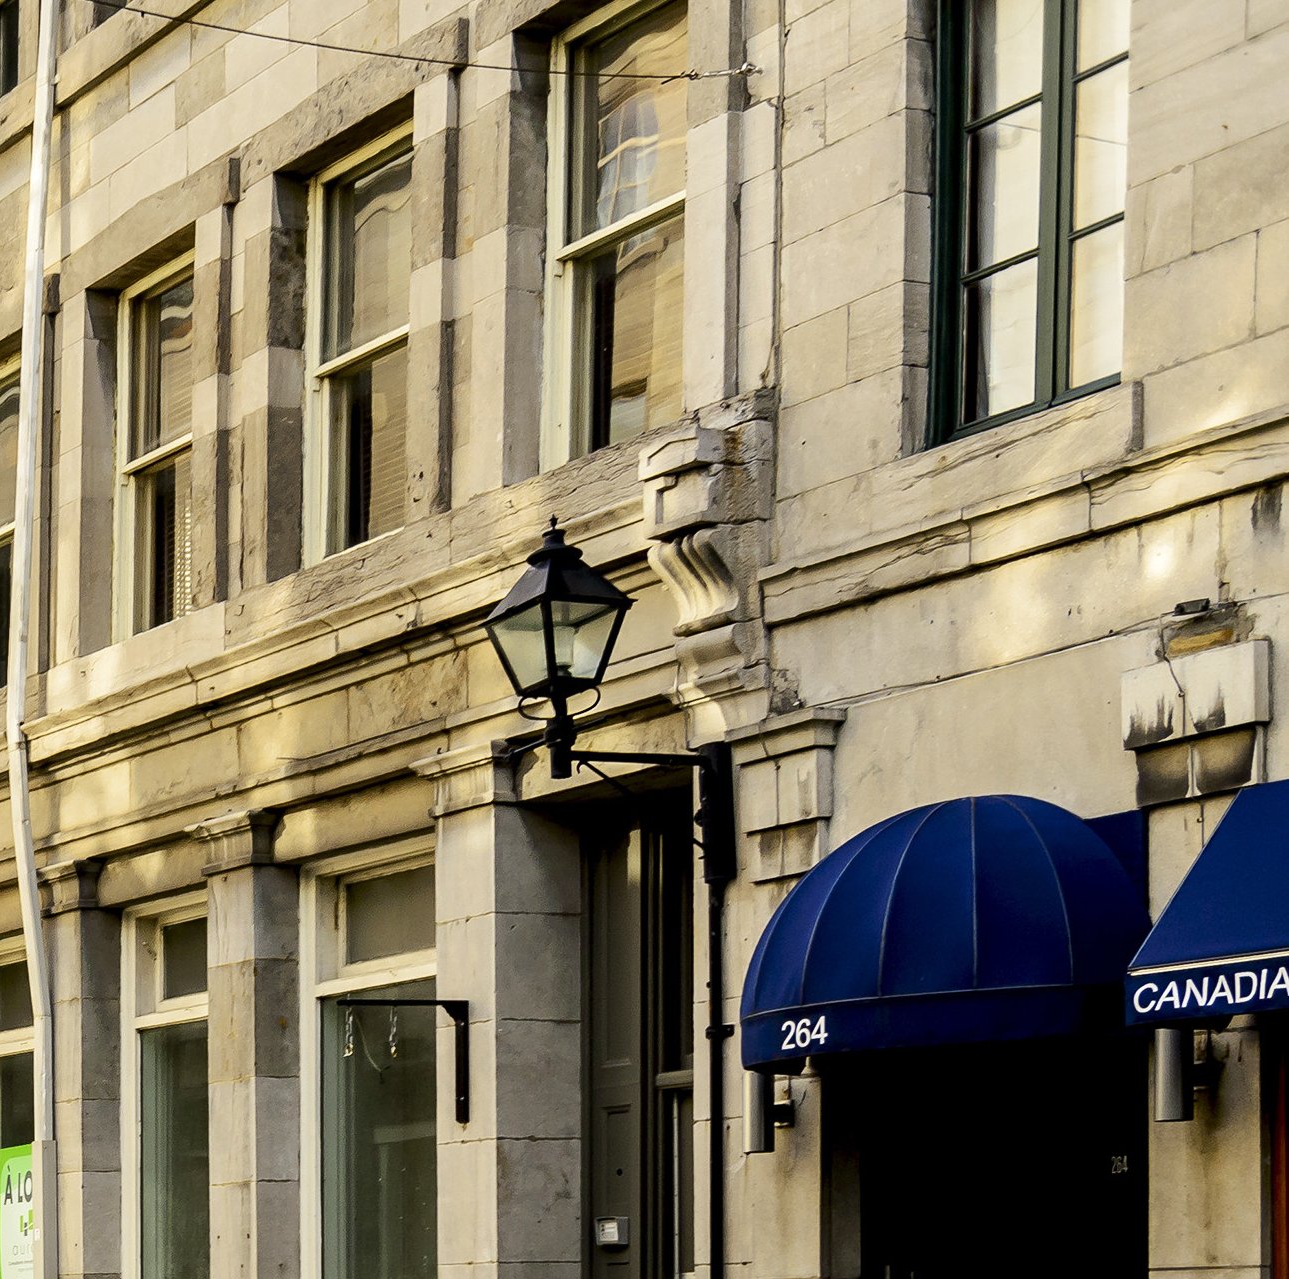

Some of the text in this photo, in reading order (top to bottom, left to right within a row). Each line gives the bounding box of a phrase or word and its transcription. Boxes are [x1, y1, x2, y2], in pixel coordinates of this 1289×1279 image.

[1133, 966, 1289, 1014] CANADIA
[781, 1015, 829, 1050] 264
[1111, 1155, 1128, 1174] 264
[4, 1165, 13, 1205] À
